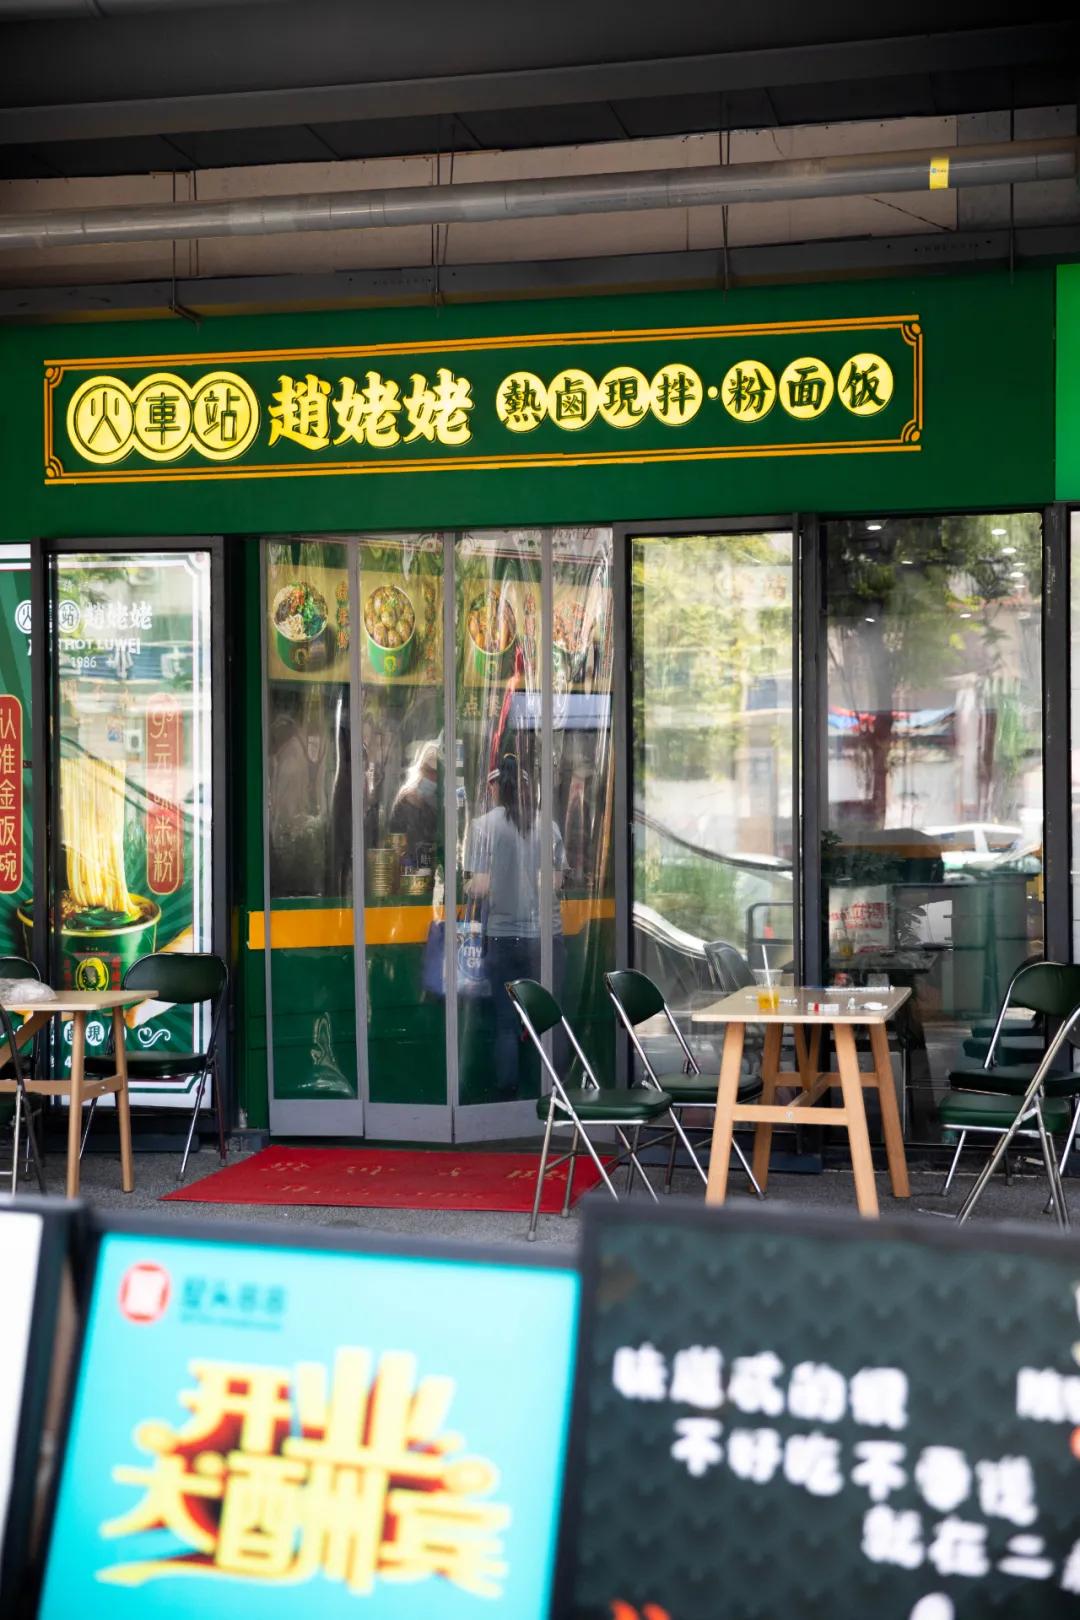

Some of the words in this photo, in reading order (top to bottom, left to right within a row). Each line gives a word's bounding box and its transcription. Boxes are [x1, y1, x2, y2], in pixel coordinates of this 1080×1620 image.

[78, 379, 250, 455] 火車站
[268, 368, 472, 450] 趙姥姥
[71, 656, 97, 668] 1986
